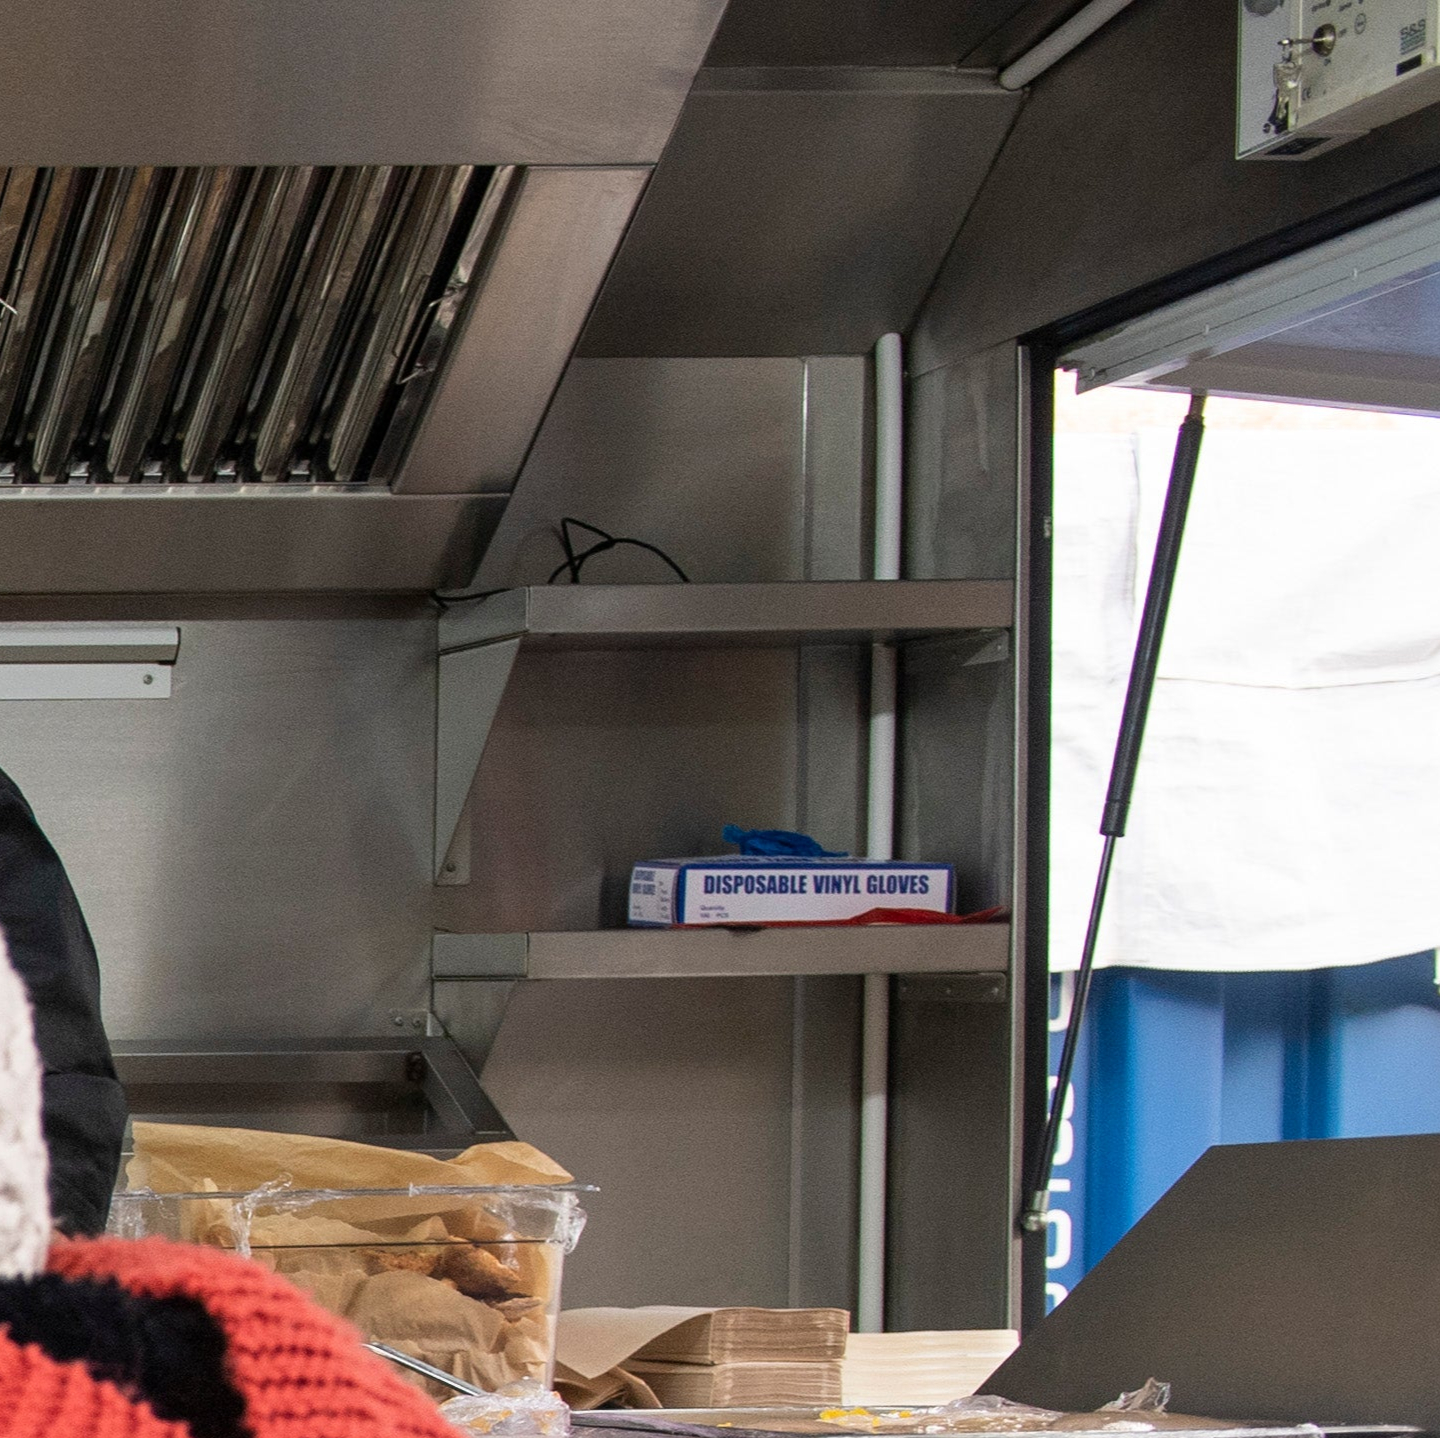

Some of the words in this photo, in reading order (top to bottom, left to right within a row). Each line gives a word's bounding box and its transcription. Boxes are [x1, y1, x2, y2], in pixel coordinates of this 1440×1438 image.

[703, 874, 808, 895] DISPOSABLE
[812, 874, 861, 895] VINYL
[866, 874, 930, 895] GLOVES
